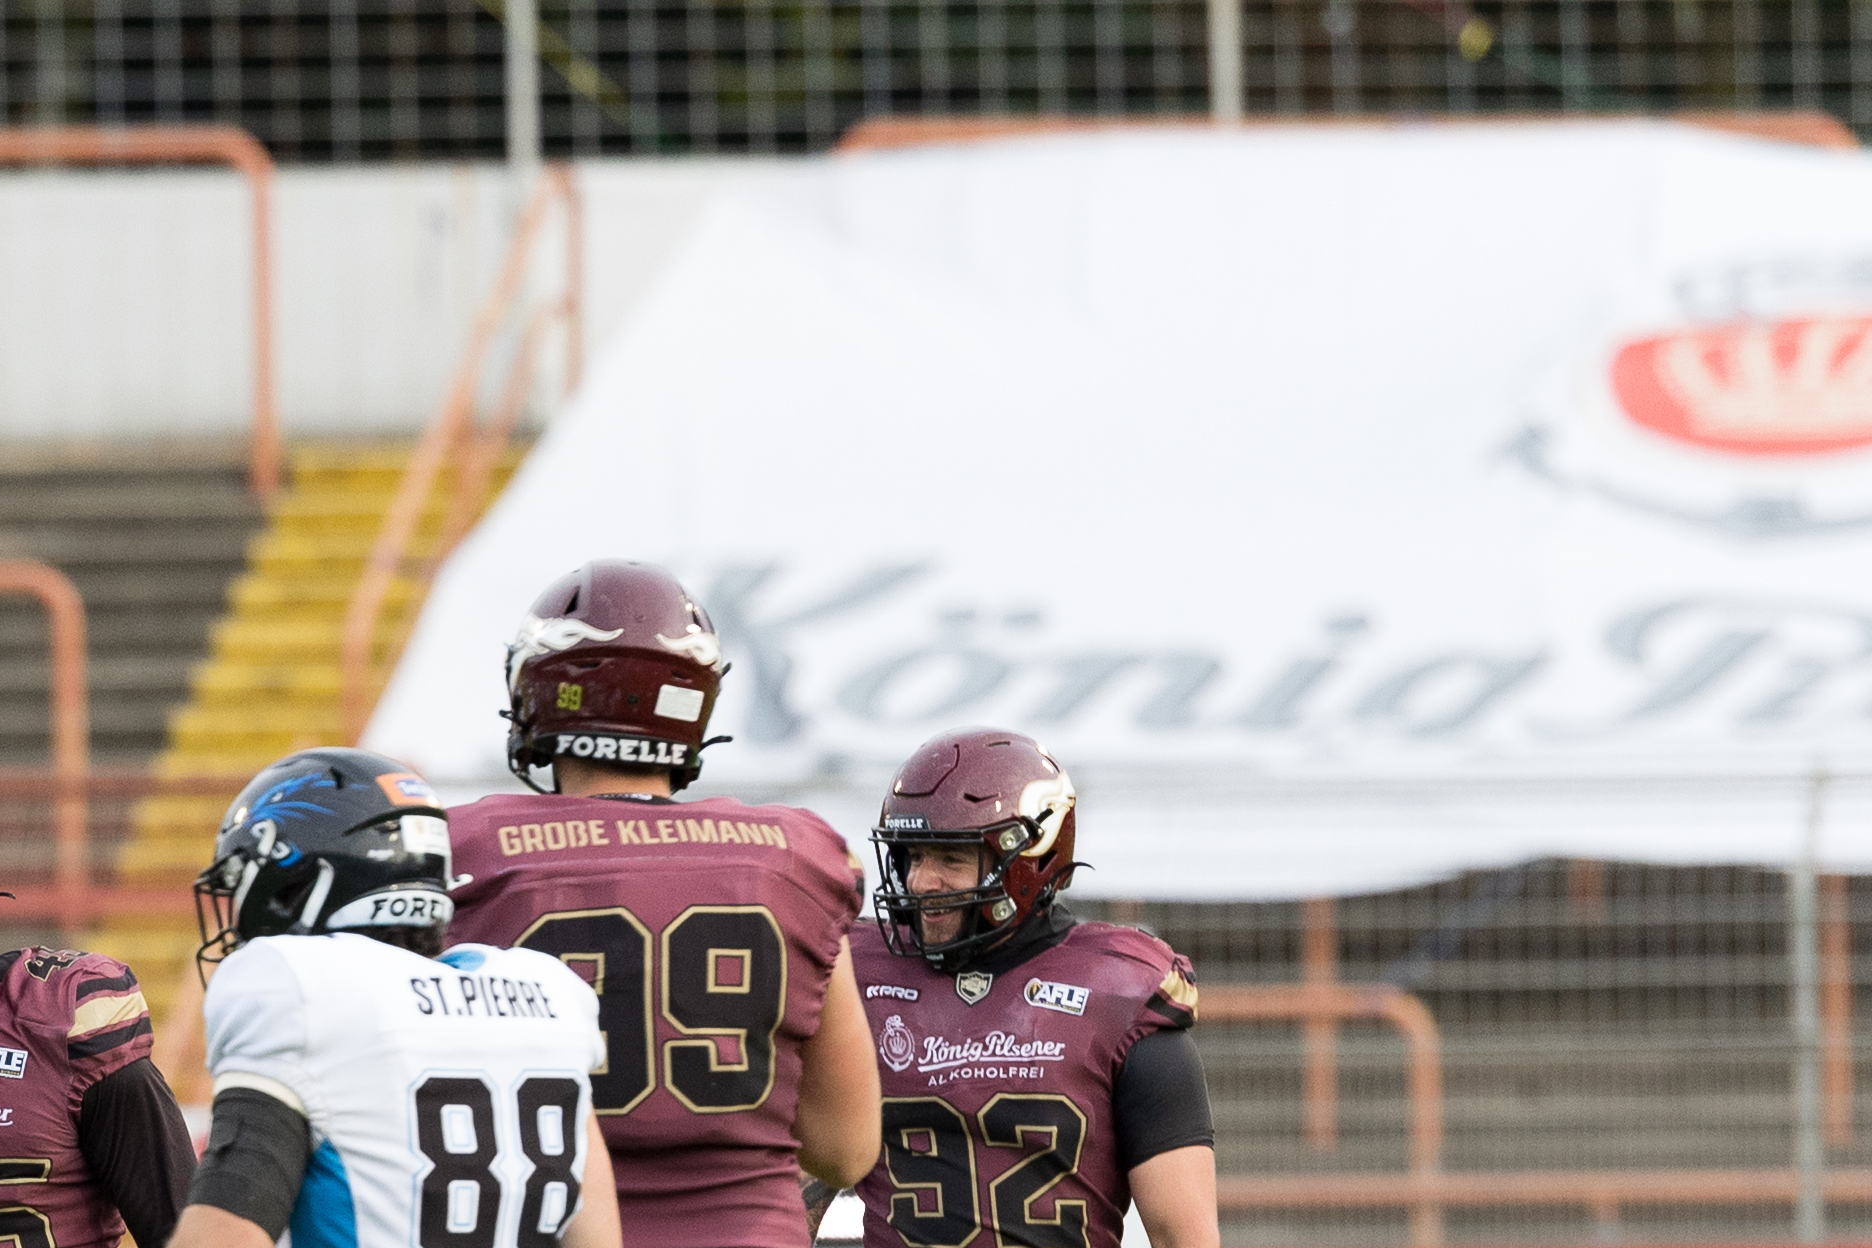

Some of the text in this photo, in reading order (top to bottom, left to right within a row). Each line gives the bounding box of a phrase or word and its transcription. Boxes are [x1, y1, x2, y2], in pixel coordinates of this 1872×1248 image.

[556, 735, 689, 765] FORELLE
[616, 818, 789, 850] KLEIMANN
[1034, 983, 1085, 1009] AFLE
[928, 1066, 1044, 1087] ALKOHOLFREI
